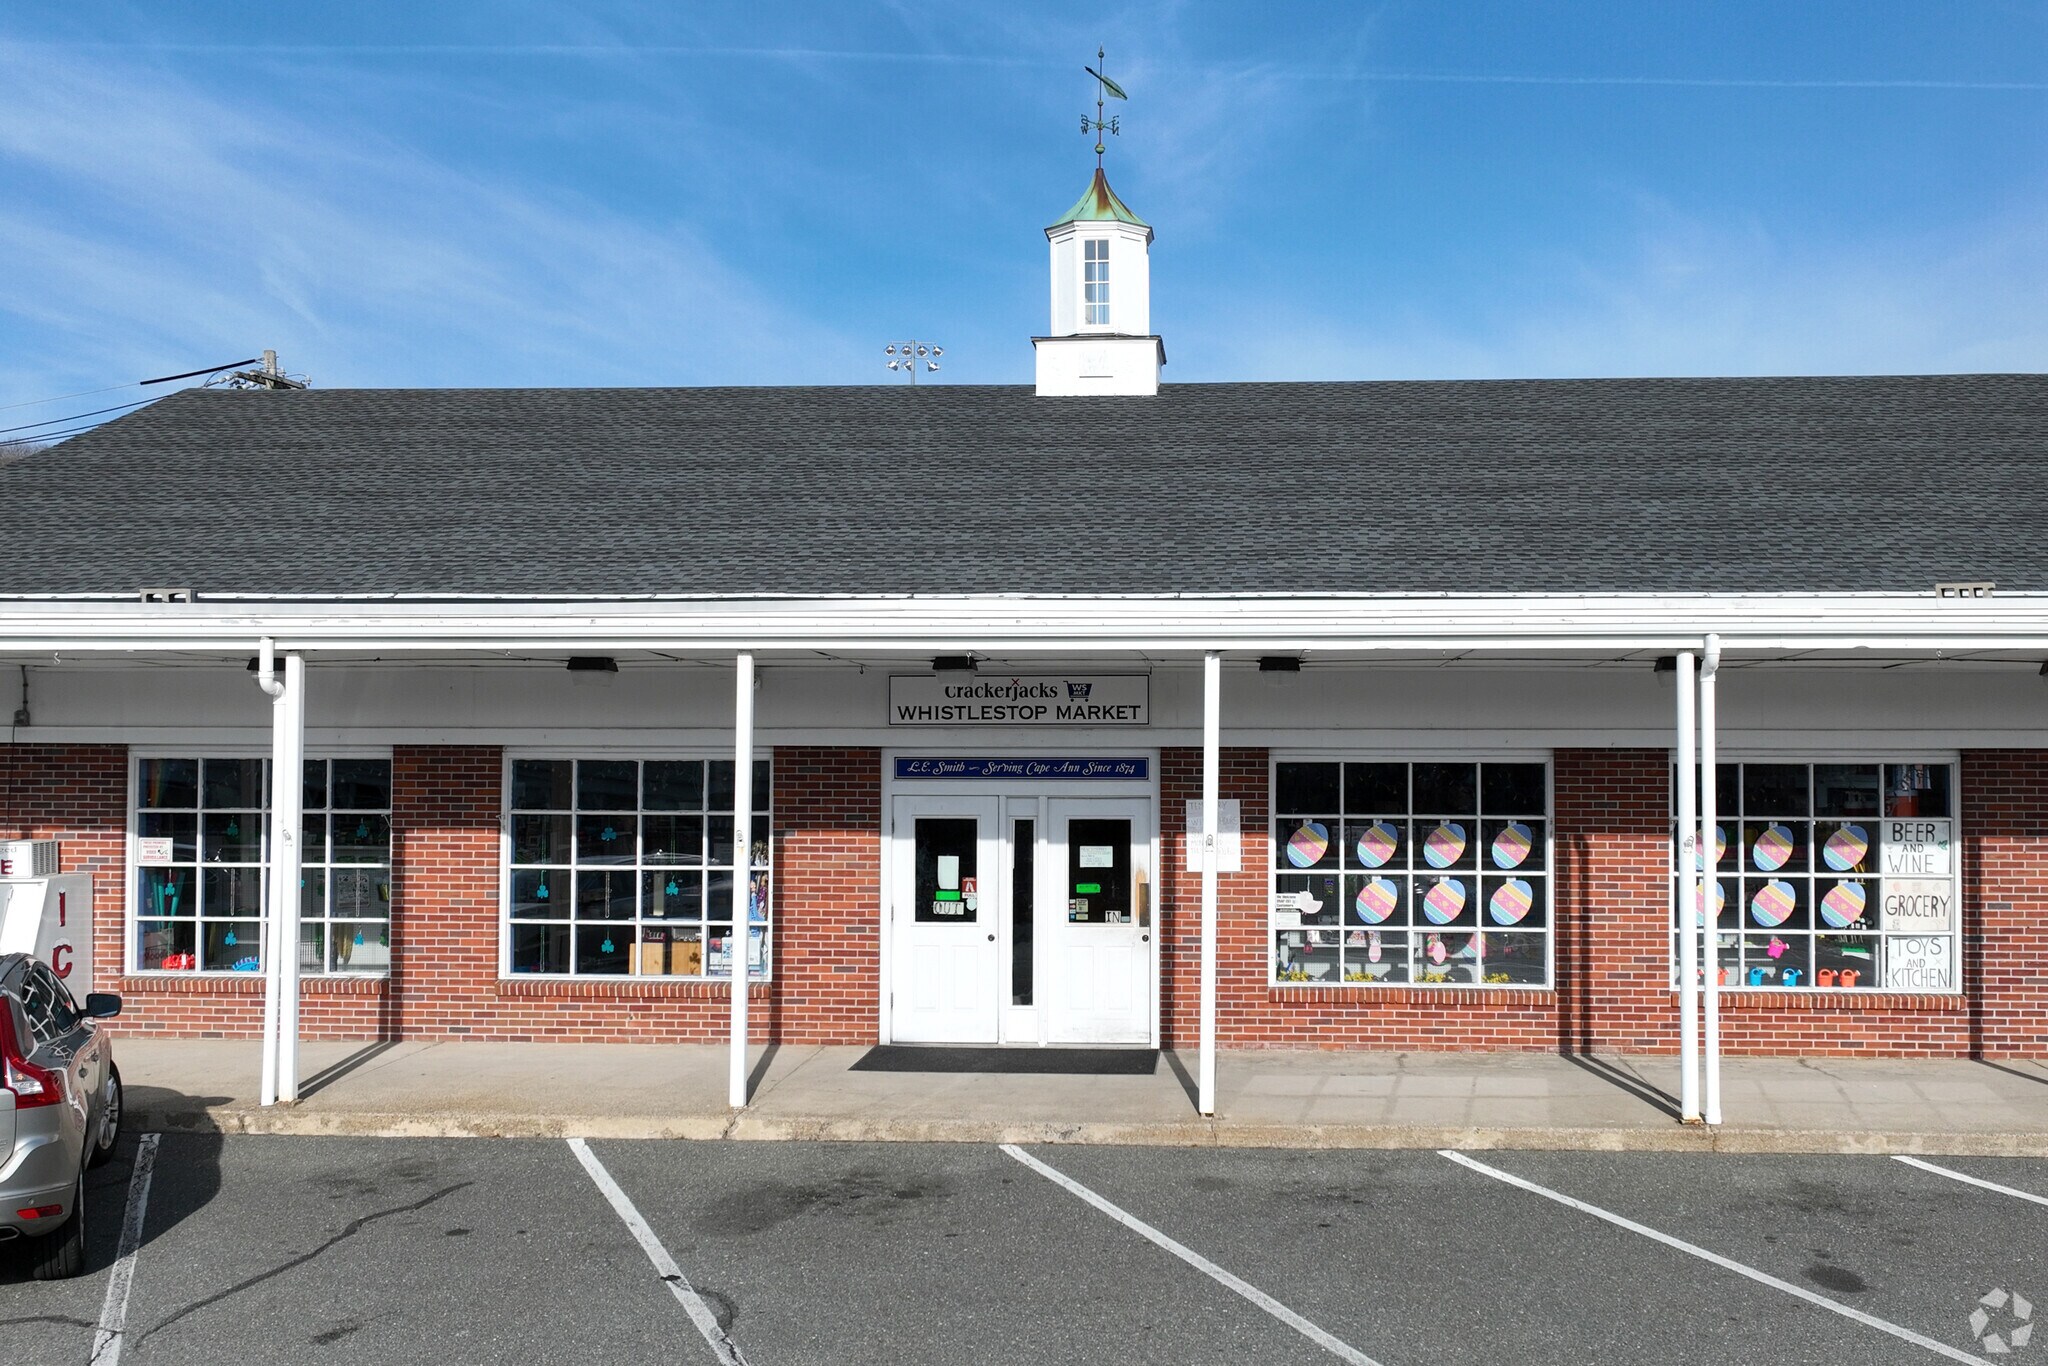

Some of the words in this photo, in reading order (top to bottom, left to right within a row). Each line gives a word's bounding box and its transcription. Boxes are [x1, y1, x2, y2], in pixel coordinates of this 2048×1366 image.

[944, 681, 1058, 702] Crackerjacks
[1071, 683, 1088, 691] WS
[897, 705, 1047, 720] WHISTLESTOP
[1056, 705, 1141, 720] MARKET
[932, 761, 966, 776] Smith
[982, 761, 1024, 775] Serving
[1026, 762, 1051, 776] Cape
[1053, 762, 1080, 773] Ann
[1082, 762, 1112, 776] Since
[1114, 763, 1136, 775] 1874
[1892, 822, 1936, 842] BEER
[1902, 844, 1924, 853] AND
[1888, 854, 1934, 873] WINE
[934, 902, 961, 914] OUT
[1885, 895, 1951, 917] GROCERY
[1106, 911, 1121, 923] IN
[1892, 937, 1942, 957] TOYS
[1906, 958, 1926, 968] AND
[1891, 968, 1949, 988] KITCHEN
